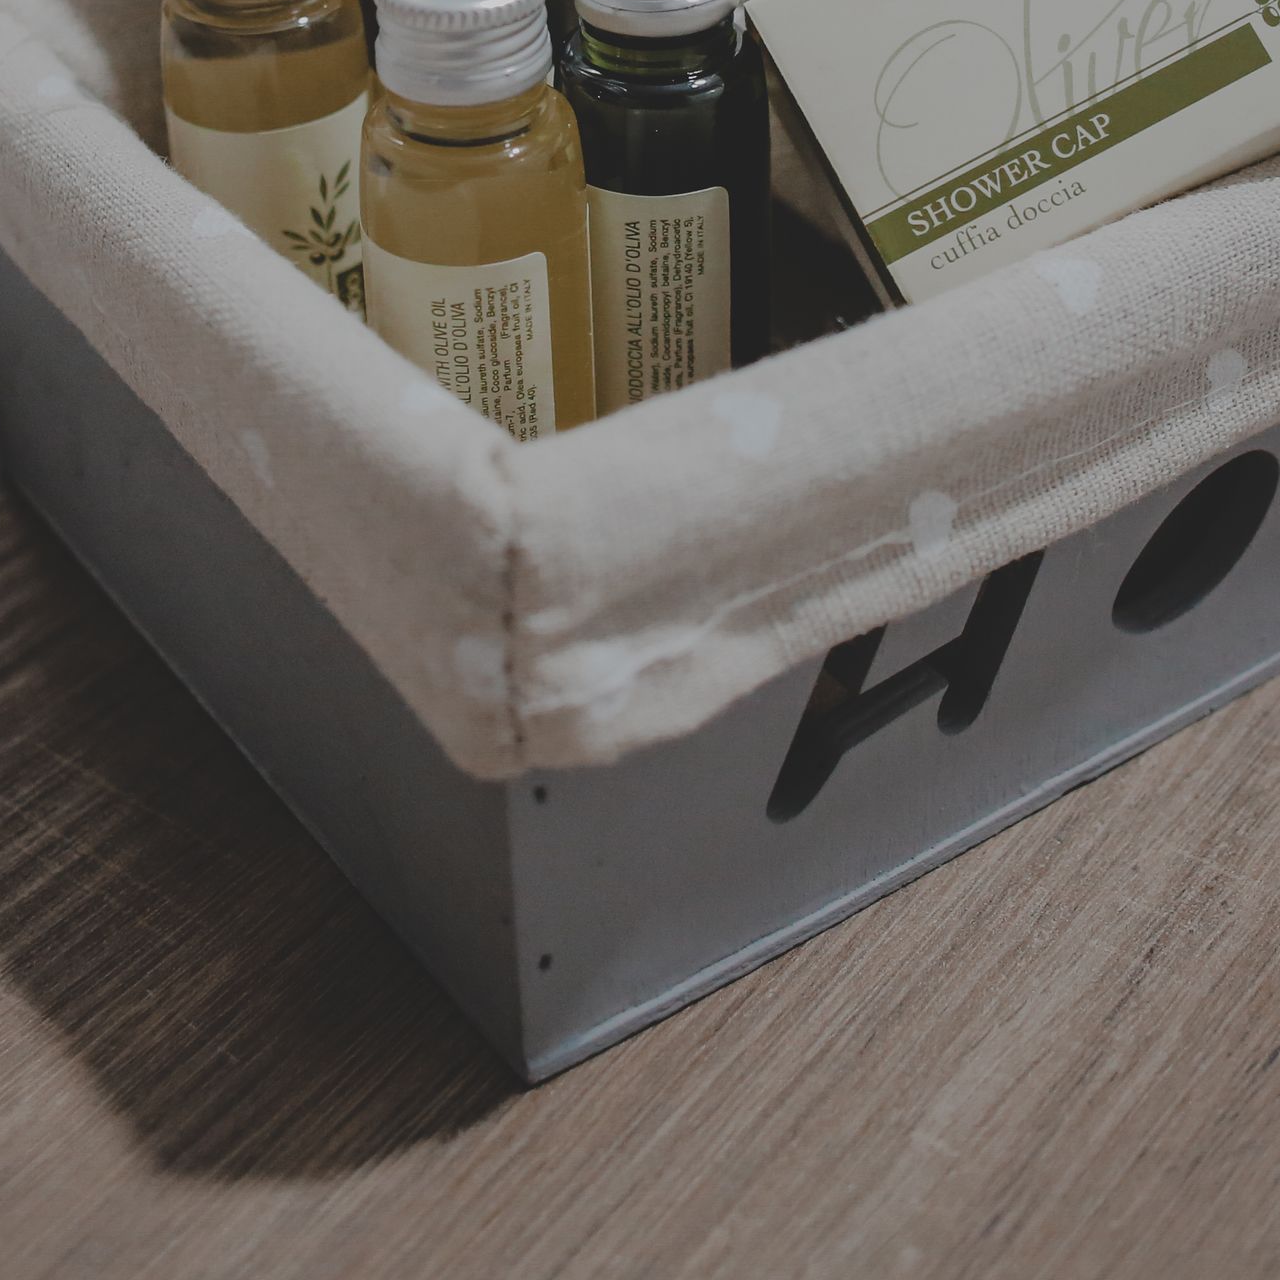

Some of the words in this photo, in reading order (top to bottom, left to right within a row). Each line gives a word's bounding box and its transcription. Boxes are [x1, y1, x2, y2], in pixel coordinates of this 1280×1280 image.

[906, 143, 1052, 239] SHOWER
[1048, 111, 1114, 162] CAP
[648, 220, 657, 252] Sodium
[660, 220, 670, 248] Benzyl
[928, 214, 1001, 272] cuffia
[1005, 175, 1088, 235] doccia
[624, 221, 640, 273] D'OLIVA
[672, 218, 683, 281] Dehydroacetic
[685, 230, 694, 260] (Yellow
[697, 240, 704, 248] IN
[649, 257, 659, 288] sulfate,
[661, 252, 670, 287] betaine,
[685, 264, 693, 289] 19140
[431, 298, 446, 317] OIL
[474, 289, 483, 323] Sodium
[486, 287, 496, 317] Benzyl
[525, 304, 531, 313] IN
[626, 278, 642, 336] ALL'OLIO
[650, 293, 658, 322] laureth
[451, 302, 467, 350] D'OLIVA
[512, 313, 520, 331] fruit
[432, 321, 448, 356] OLIVE
[476, 327, 485, 359] sulfate,
[488, 320, 500, 366] glucoside,
[650, 326, 658, 358] Sodium
[674, 338, 683, 368] Parfum
[477, 364, 487, 394] laureth
[491, 370, 500, 393] Coco
[504, 360, 512, 391] Parfum
[517, 402, 526, 424] acid,
